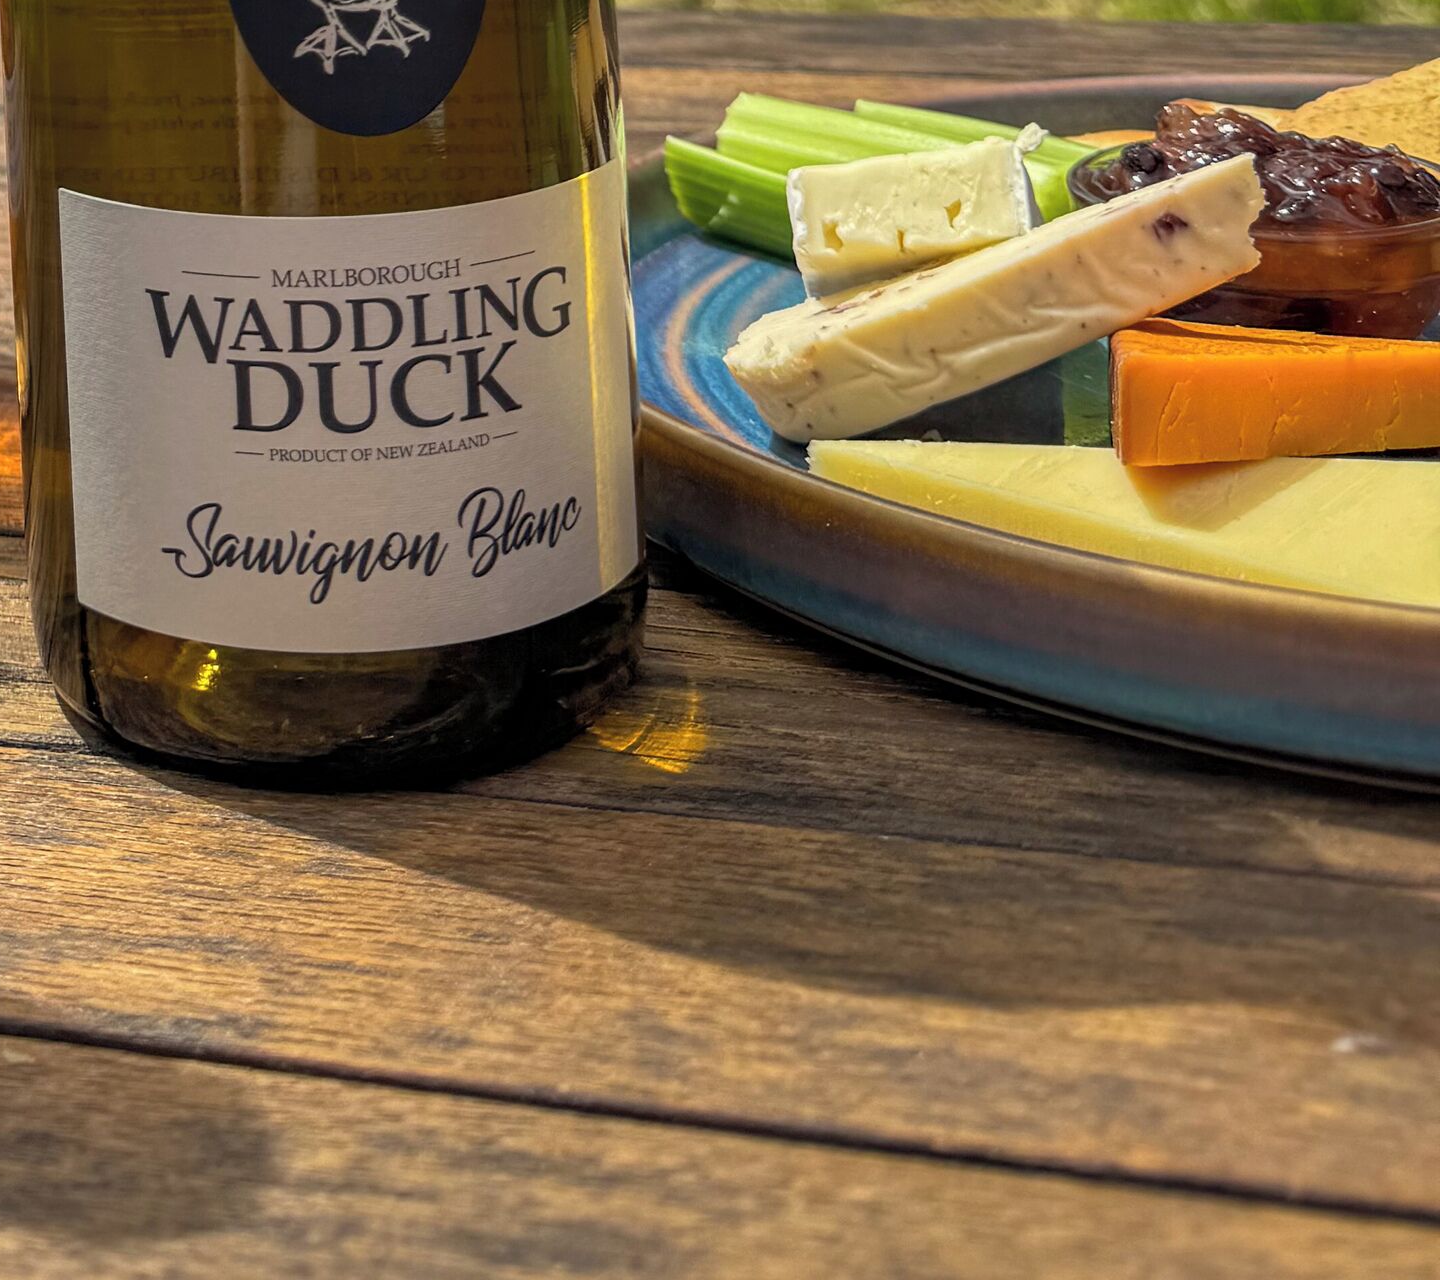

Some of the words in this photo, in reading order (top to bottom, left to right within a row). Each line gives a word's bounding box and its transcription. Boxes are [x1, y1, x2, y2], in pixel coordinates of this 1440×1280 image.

[144, 265, 573, 365] WADDLING
[270, 258, 462, 289] MARLBOROUGH
[226, 340, 523, 434] DUCK
[268, 447, 348, 464] PRODUCT
[350, 446, 374, 462] OF
[375, 443, 415, 461] NEW
[417, 433, 491, 459] ZEALAND
[161, 502, 452, 605] Sauvignon
[457, 486, 582, 578] Blanc
